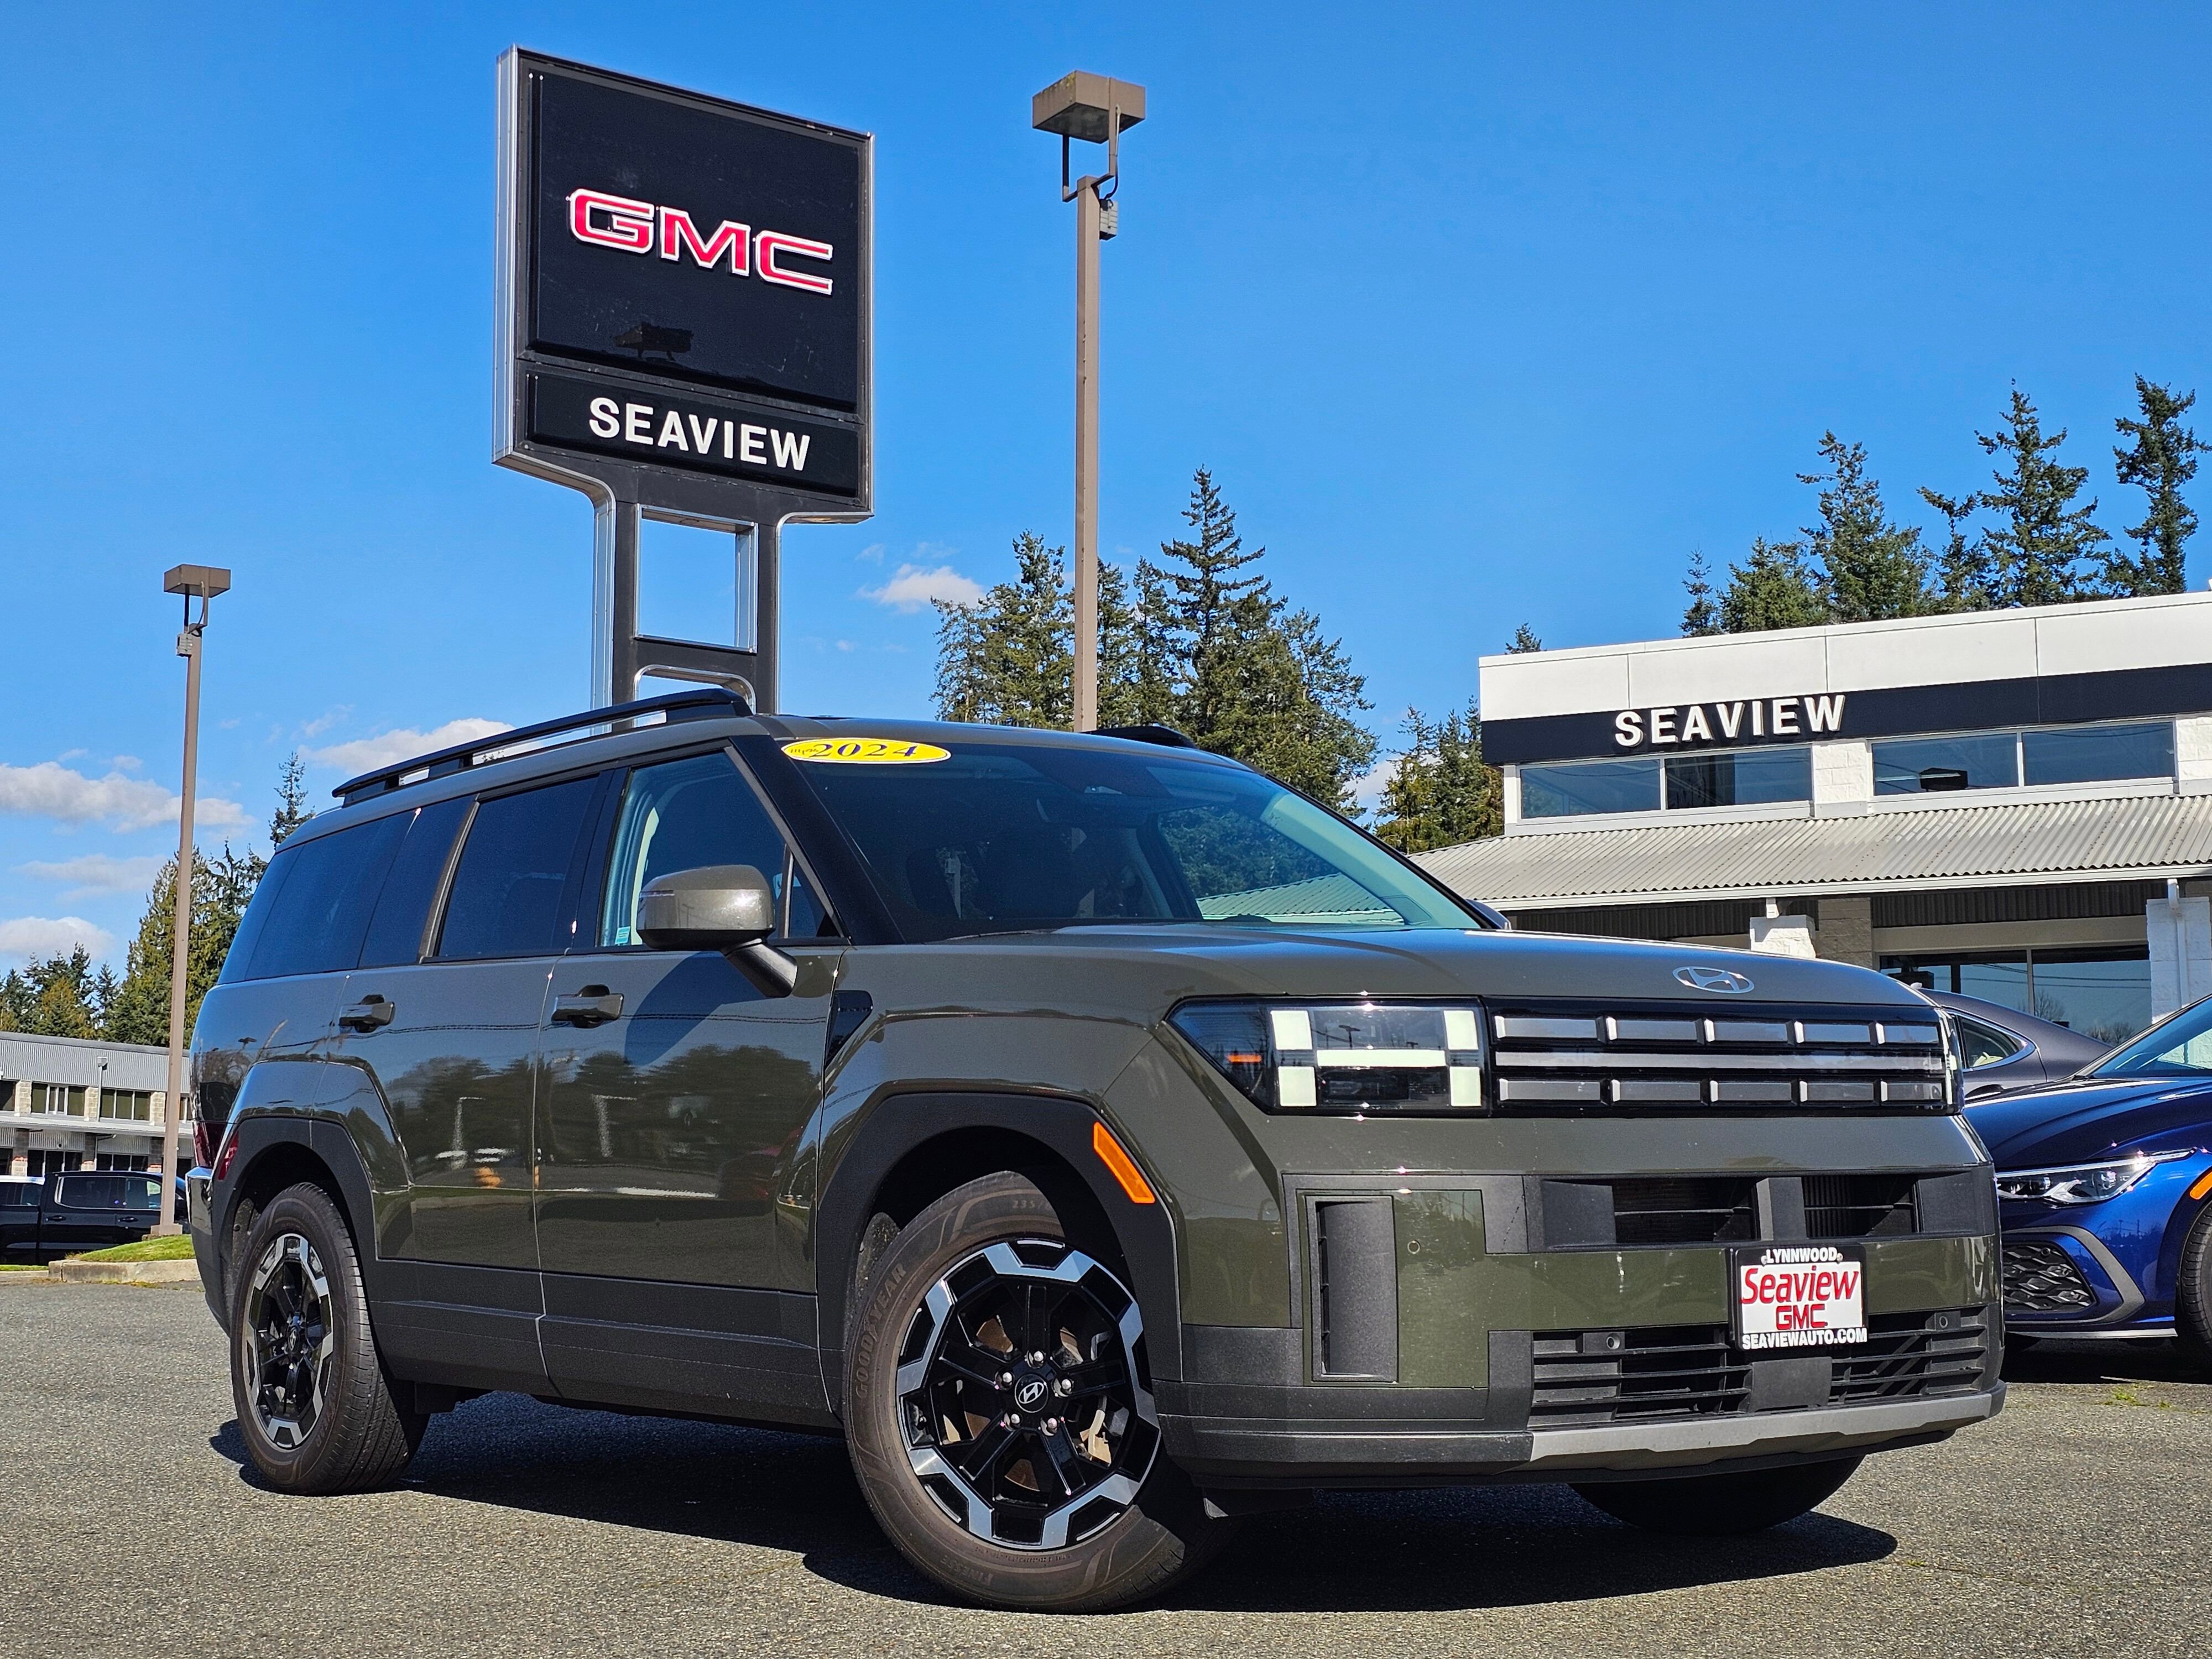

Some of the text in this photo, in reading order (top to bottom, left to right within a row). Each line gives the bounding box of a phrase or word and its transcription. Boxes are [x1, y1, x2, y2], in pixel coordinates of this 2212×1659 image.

[570, 189, 833, 295] GMC
[589, 397, 810, 471] SEAVIEW
[1615, 695, 1845, 748] SEAVIEW
[809, 742, 919, 758] 2024
[1765, 1247, 1838, 1264] LYNNWOOD
[1740, 1265, 1859, 1305] Seaview
[855, 1262, 907, 1399] GOODYEAR
[1776, 1303, 1829, 1331] GMC
[1742, 1327, 1867, 1350] SEAVIEWAUTO.COM
